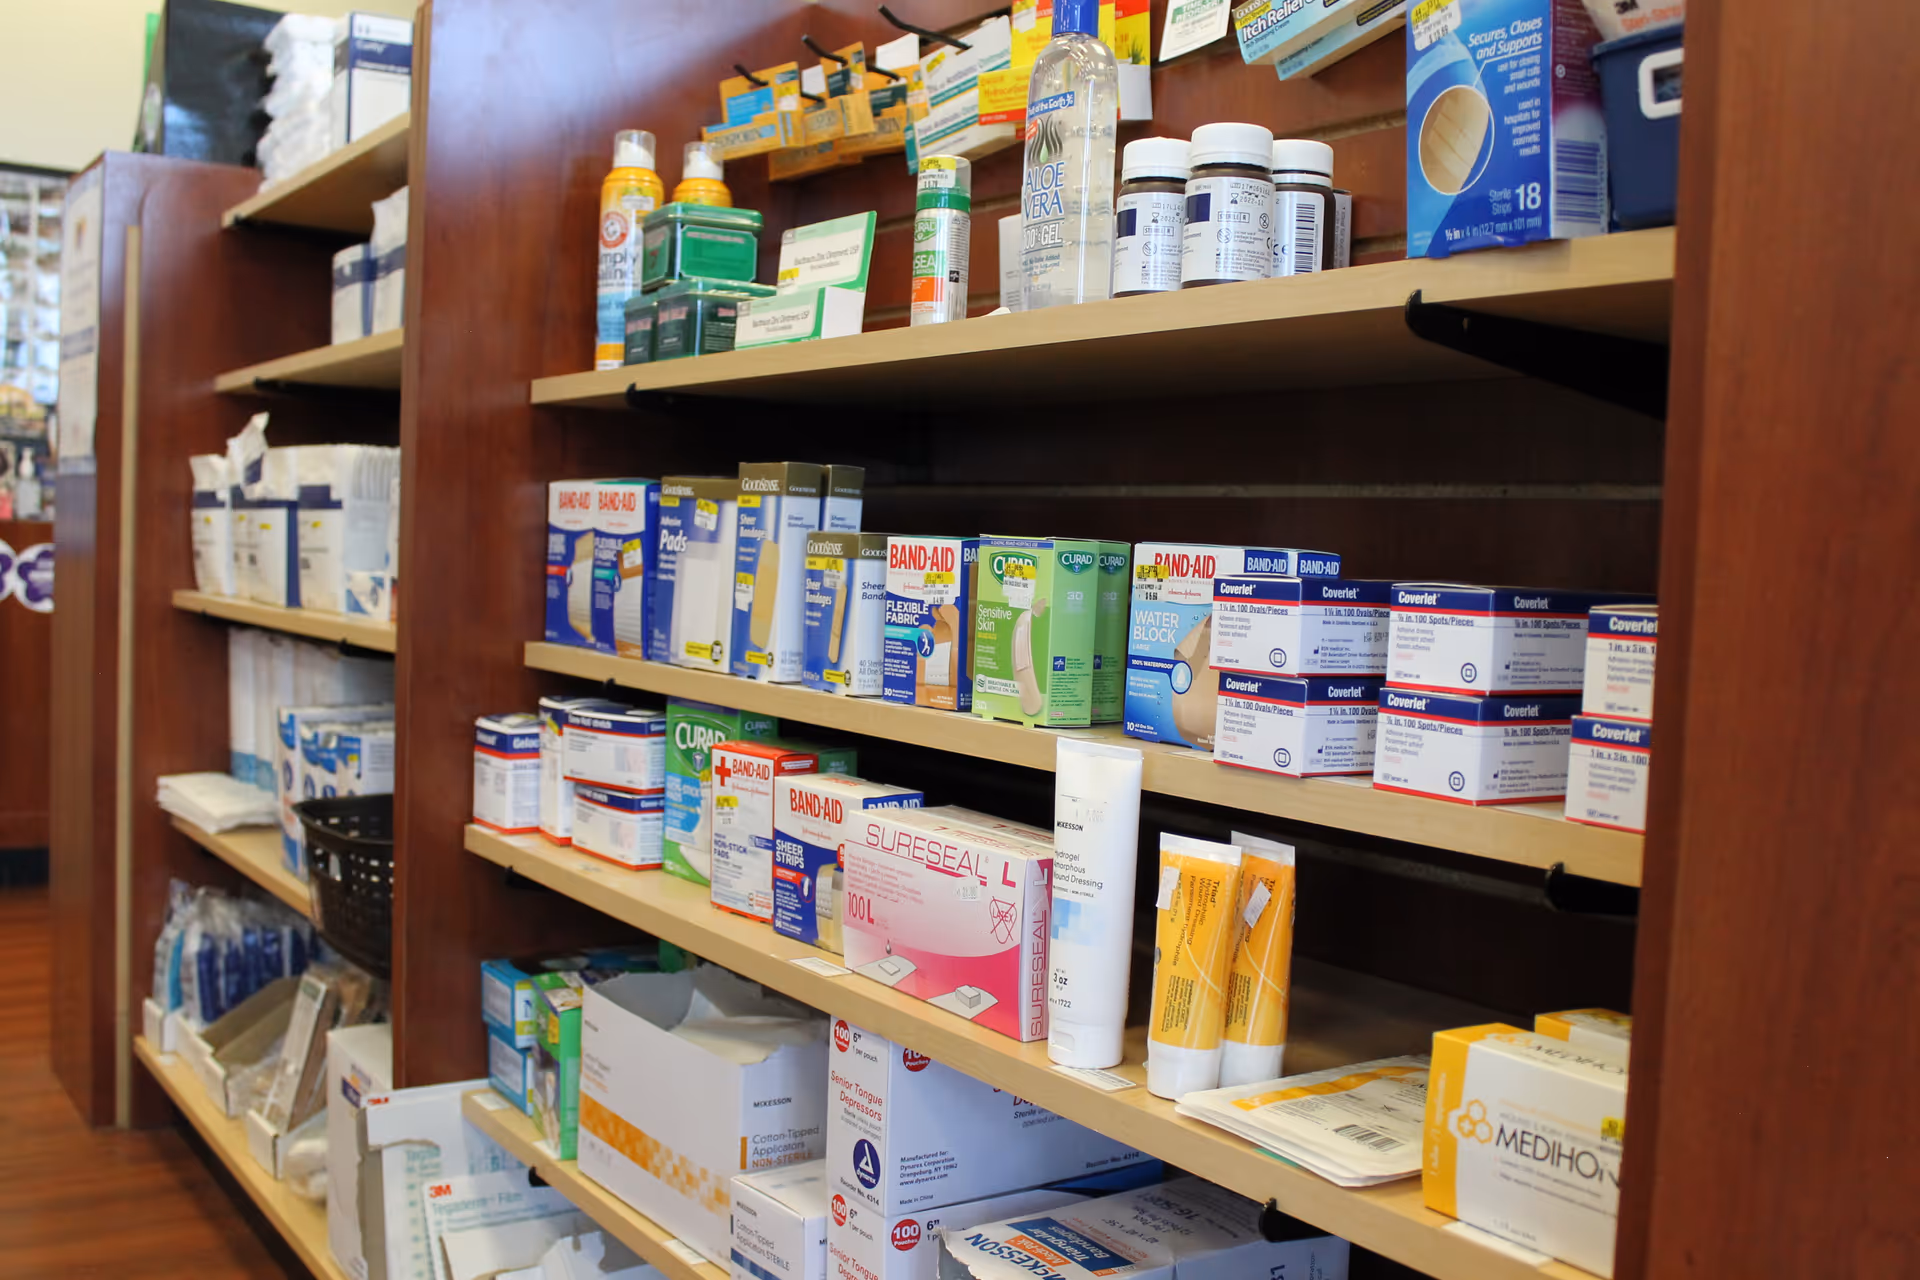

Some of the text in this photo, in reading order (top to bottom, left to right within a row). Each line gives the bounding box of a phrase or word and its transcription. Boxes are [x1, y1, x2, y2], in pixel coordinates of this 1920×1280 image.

[1242, 18, 1268, 44] Itch
[1468, 17, 1543, 48] Secures, Closes
[1476, 31, 1543, 60] and Supports
[1497, 53, 1541, 72] use for closing
[1510, 69, 1526, 81] small
[1504, 78, 1541, 95] and wounds
[1041, 93, 1067, 111] the Earth
[1518, 97, 1541, 110] used in
[1504, 110, 1541, 125] hospitals for
[1512, 121, 1541, 138] improved
[1512, 133, 1541, 147] cosmetic
[1519, 145, 1541, 157] results
[1026, 162, 1065, 193] ALOE
[1489, 188, 1512, 203] Sterile
[1515, 182, 1542, 210] 18
[1024, 189, 1064, 221] VERA
[1492, 201, 1512, 216] Strips
[1041, 222, 1063, 245] GEL
[598, 490, 637, 512] BAND-AID
[659, 529, 688, 552] Pads
[807, 540, 844, 556] GOODSENSE
[889, 543, 955, 572] BAND-AID
[1061, 553, 1093, 566] CURAD
[1099, 555, 1125, 567] CURAD
[1154, 553, 1216, 578] BAND-AID
[1247, 556, 1287, 573] BAND-AID
[1300, 558, 1340, 575] BAND-AID
[805, 578, 822, 591] Sheer
[861, 581, 885, 590] Sheer
[1220, 582, 1253, 595] Coverlet
[1323, 586, 1357, 599] Coverlet
[1398, 591, 1437, 605] Coverlet
[1514, 596, 1549, 609] Coverlet
[885, 600, 929, 615] FLEXIBLE
[978, 604, 1012, 621] Sensitive
[1237, 604, 1289, 616] 100 Ovals/Pieces
[1344, 608, 1355, 617] 100
[885, 612, 920, 626] FABRIC
[977, 617, 995, 633] Skin
[1135, 610, 1179, 628] WATER
[1415, 615, 1474, 627] 100 Spots/Pieces
[1134, 627, 1177, 644] BLOCK
[1131, 659, 1174, 670] 100% WATERPROOF
[884, 687, 893, 696] 30
[1226, 677, 1259, 693] Coverlet
[1328, 686, 1362, 698] Coverlet
[1243, 701, 1294, 717] 100 Ovals/Pieces
[1387, 693, 1426, 711] Coverlet
[1349, 707, 1360, 716] 100
[1504, 704, 1539, 718] Coverlet
[1127, 721, 1135, 731] 10
[1404, 719, 1463, 736] 100 Spots/Pieces
[1520, 727, 1531, 737] 100
[1592, 723, 1640, 743] Coverlet
[675, 722, 725, 752] CURAD
[1631, 754, 1648, 766] 100
[732, 758, 770, 782] BAND-AID
[790, 788, 844, 825] BAND-AID
[775, 839, 804, 856] SHEER
[866, 823, 987, 880] SURESEAL
[1002, 861, 1016, 888] L
[775, 851, 805, 870] STRIPS
[1070, 874, 1103, 890] Dressing
[1210, 880, 1220, 904] Triad
[848, 891, 875, 925] 100 L
[1199, 878, 1213, 926] Hydrophilic
[1187, 877, 1206, 946] Wound Dressing
[1030, 868, 1048, 1037] SURESEAL L
[1053, 972, 1068, 986] 3 oz
[835, 1025, 849, 1042] 100
[863, 1050, 878, 1063] pouch
[831, 1070, 883, 1107] Senior Tongue
[840, 1091, 882, 1122] Depressors
[1013, 1108, 1037, 1120] Sterile
[752, 1124, 820, 1144] Cotton-Tipped
[752, 1140, 806, 1157] Applicators
[751, 1151, 814, 1169] NON-STERILE
[900, 1156, 955, 1171] Dynarex Corporation
[901, 1151, 938, 1163] Manufactured
[856, 1167, 878, 1187] dynarex
[899, 1173, 948, 1187] www.dynarex.com
[429, 1184, 452, 1199] 3M
[866, 1192, 880, 1206] 4314
[920, 1194, 934, 1202] China
[833, 1200, 847, 1216] 100
[736, 1219, 775, 1250] Cotton-Tipped
[860, 1228, 874, 1242] pouch
[894, 1224, 920, 1238] 100
[893, 1237, 918, 1247] Pouches
[1026, 1227, 1090, 1262] Triangular
[1047, 1225, 1111, 1259] Bandages
[1017, 1237, 1065, 1266] Medi-Pak
[829, 1241, 879, 1280] Senior Tongue
